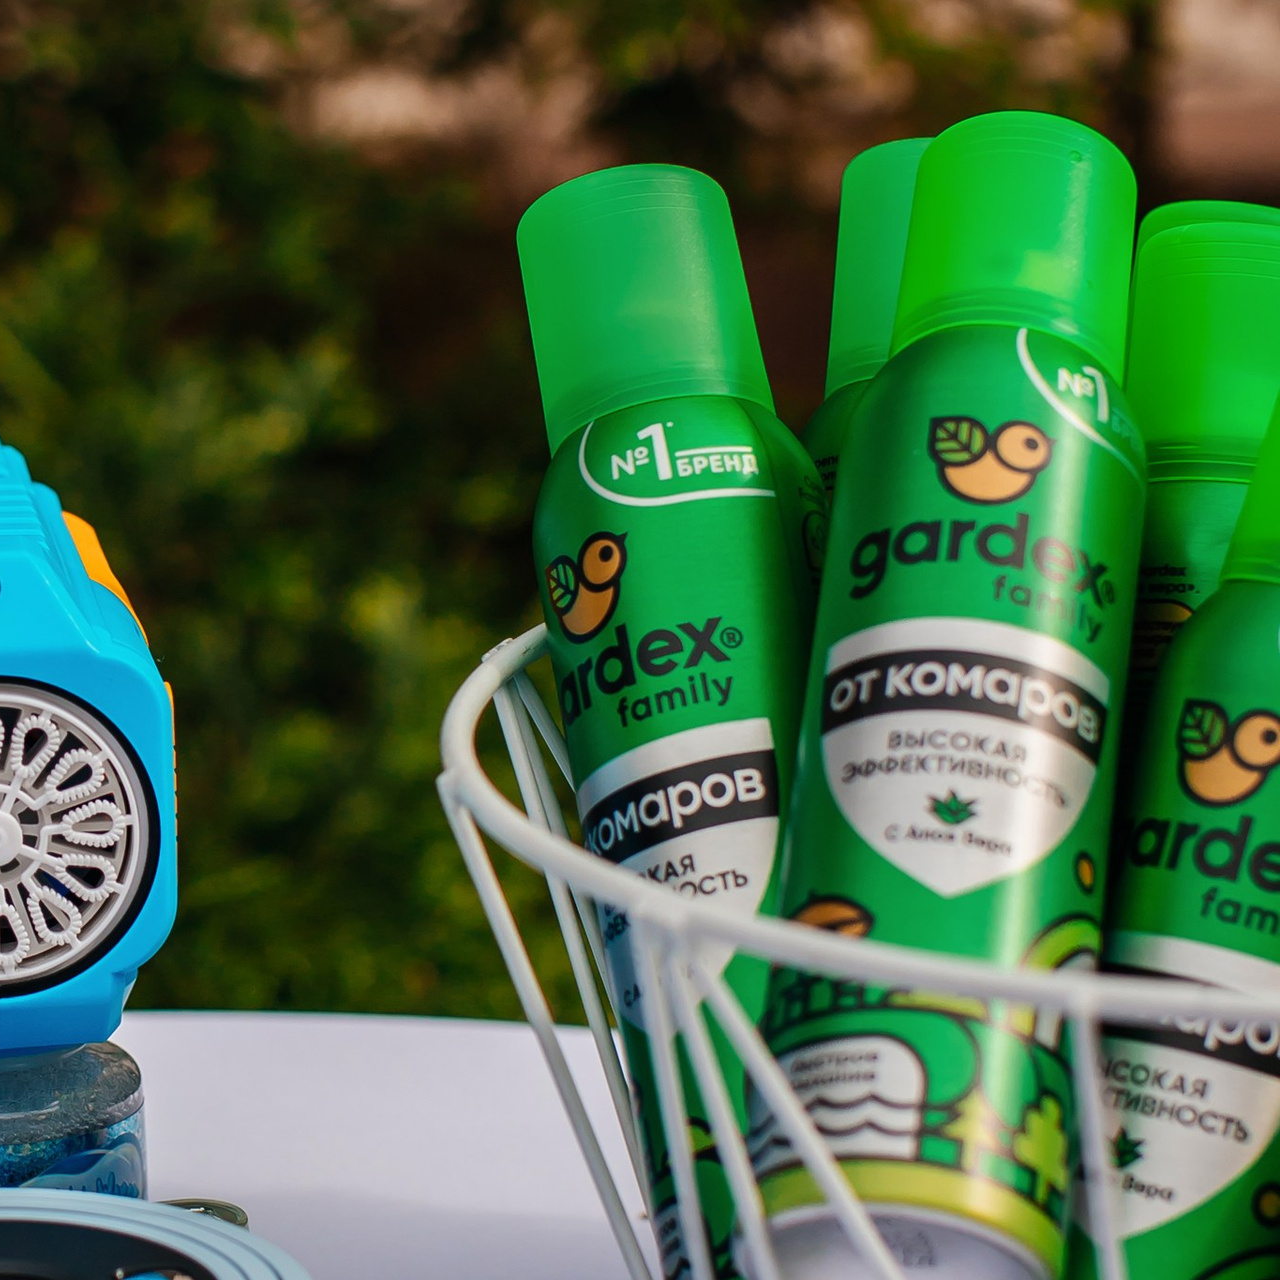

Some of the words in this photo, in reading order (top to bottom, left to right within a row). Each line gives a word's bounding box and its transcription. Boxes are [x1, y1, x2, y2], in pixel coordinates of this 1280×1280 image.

[676, 454, 759, 477] БРЕНД
[560, 616, 743, 726] ardex®
[617, 672, 733, 728] family
[887, 729, 1027, 762] ВЫСОКАЯ
[1130, 814, 1280, 893] arde
[1200, 885, 1280, 936] fam
[1104, 1057, 1208, 1099] СОКАЯ
[1106, 1086, 1250, 1143] ТИВНОСТЬ
